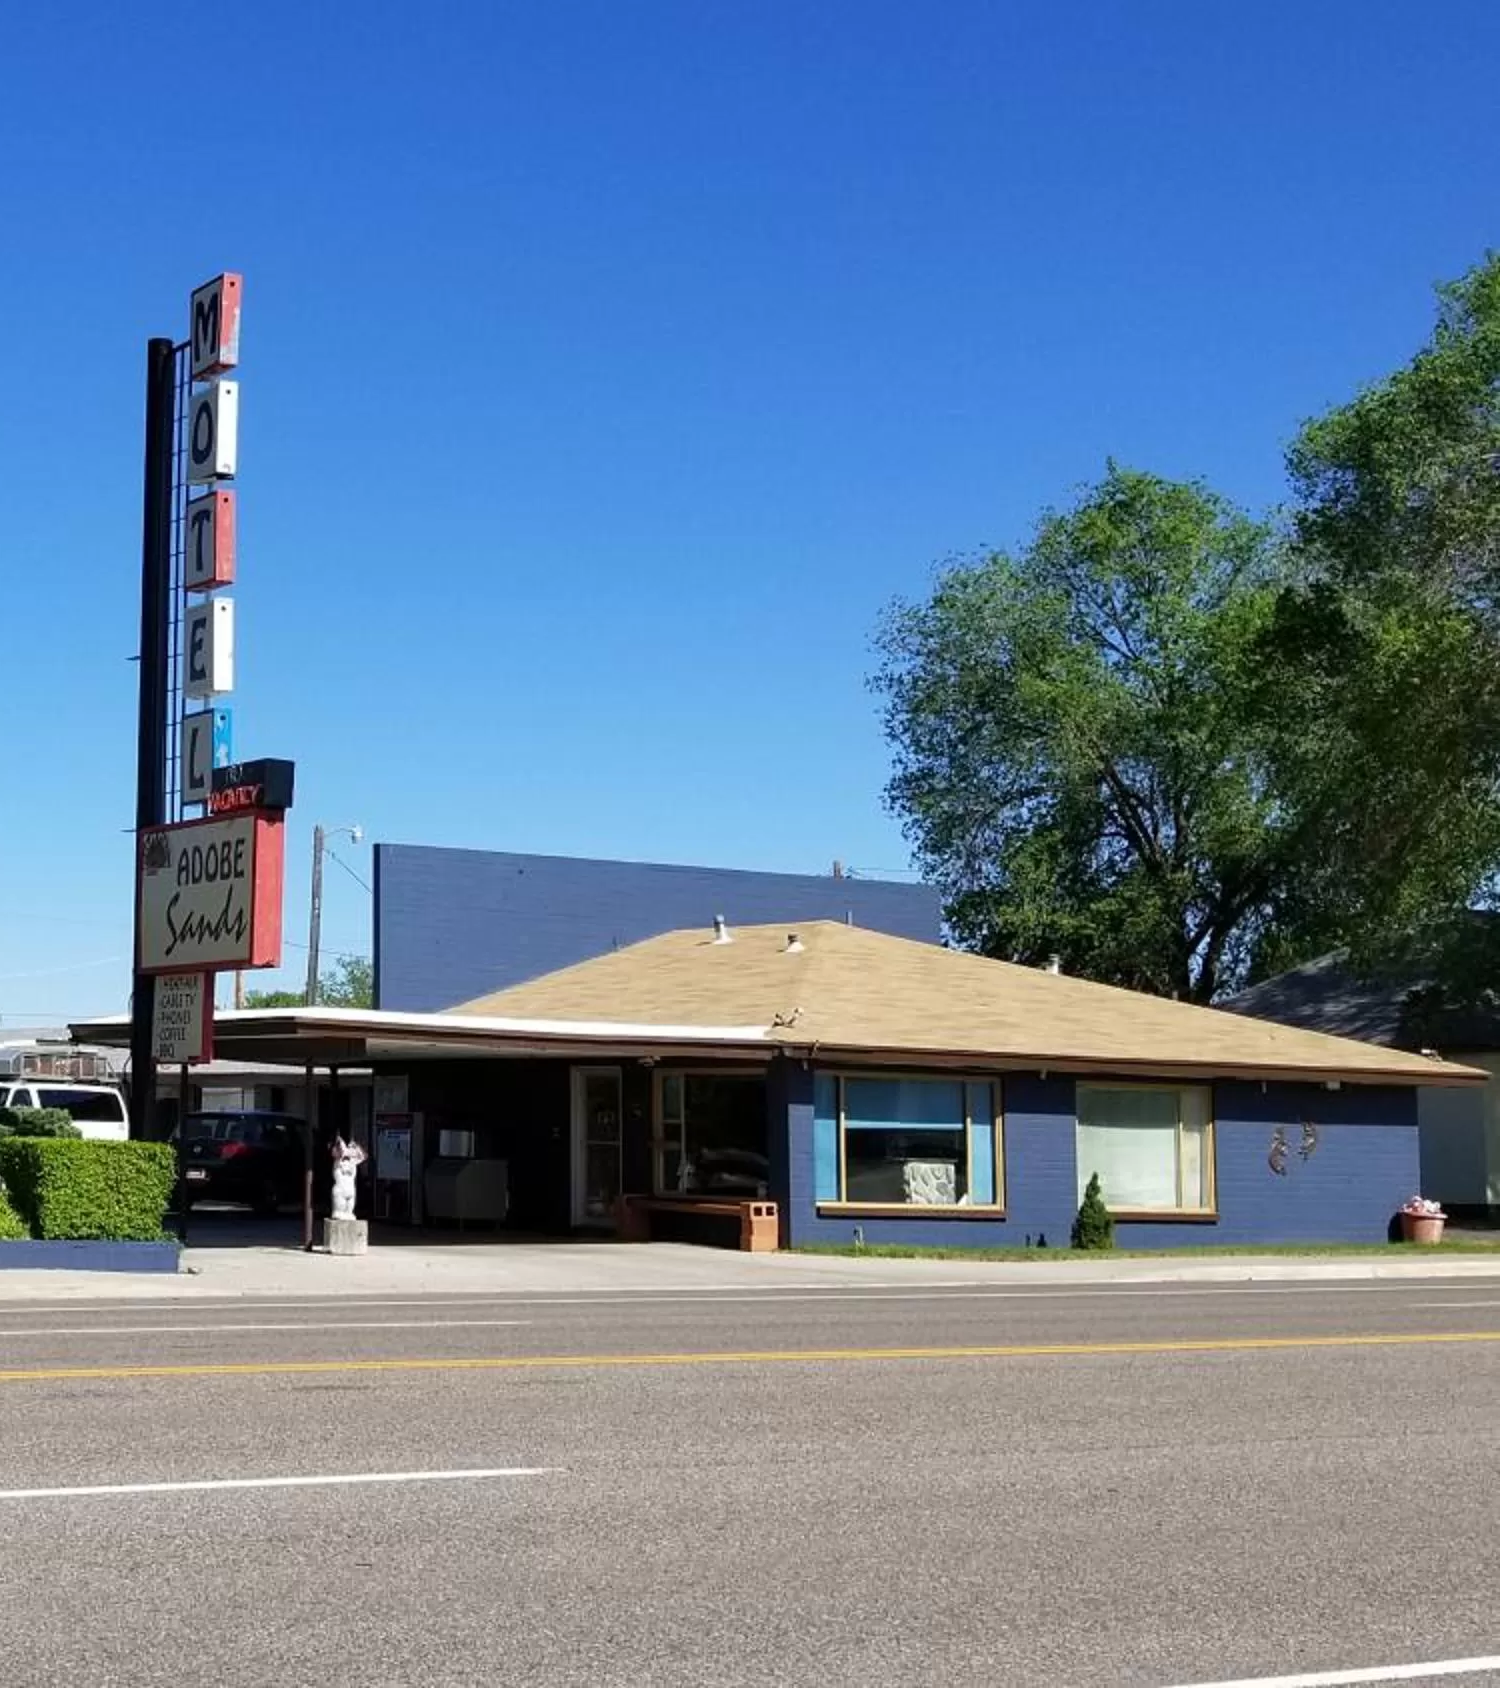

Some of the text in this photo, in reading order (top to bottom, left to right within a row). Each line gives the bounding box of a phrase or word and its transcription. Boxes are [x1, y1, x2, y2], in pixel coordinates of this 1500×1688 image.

[189, 291, 219, 790] MOTEL
[177, 837, 245, 887] ADOBE
[165, 884, 248, 956] Sands
